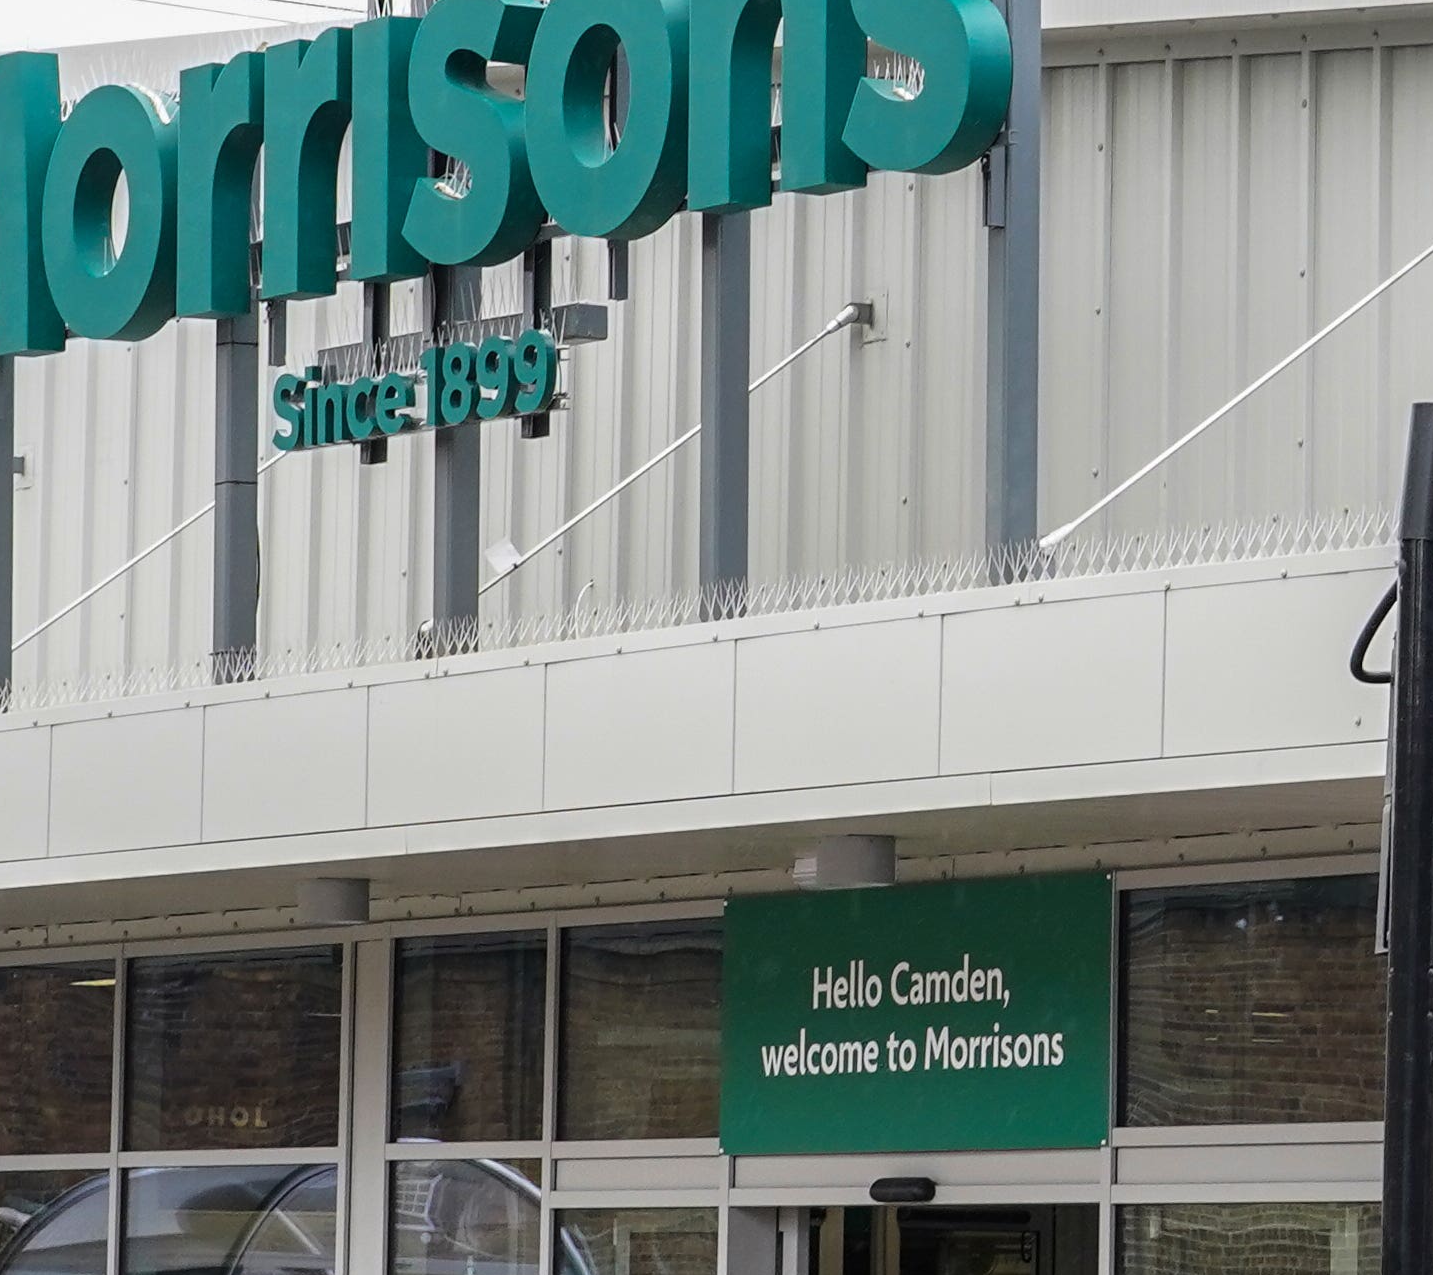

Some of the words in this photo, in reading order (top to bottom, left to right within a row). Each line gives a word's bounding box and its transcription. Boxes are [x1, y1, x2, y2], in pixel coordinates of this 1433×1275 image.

[272, 366, 415, 451] Since
[420, 329, 558, 426] 1899
[812, 959, 883, 1010] Hello
[890, 953, 1011, 1009] Camden,
[761, 1027, 879, 1077] welcome
[886, 1031, 917, 1072] to
[924, 1022, 1064, 1071] Morrisons
